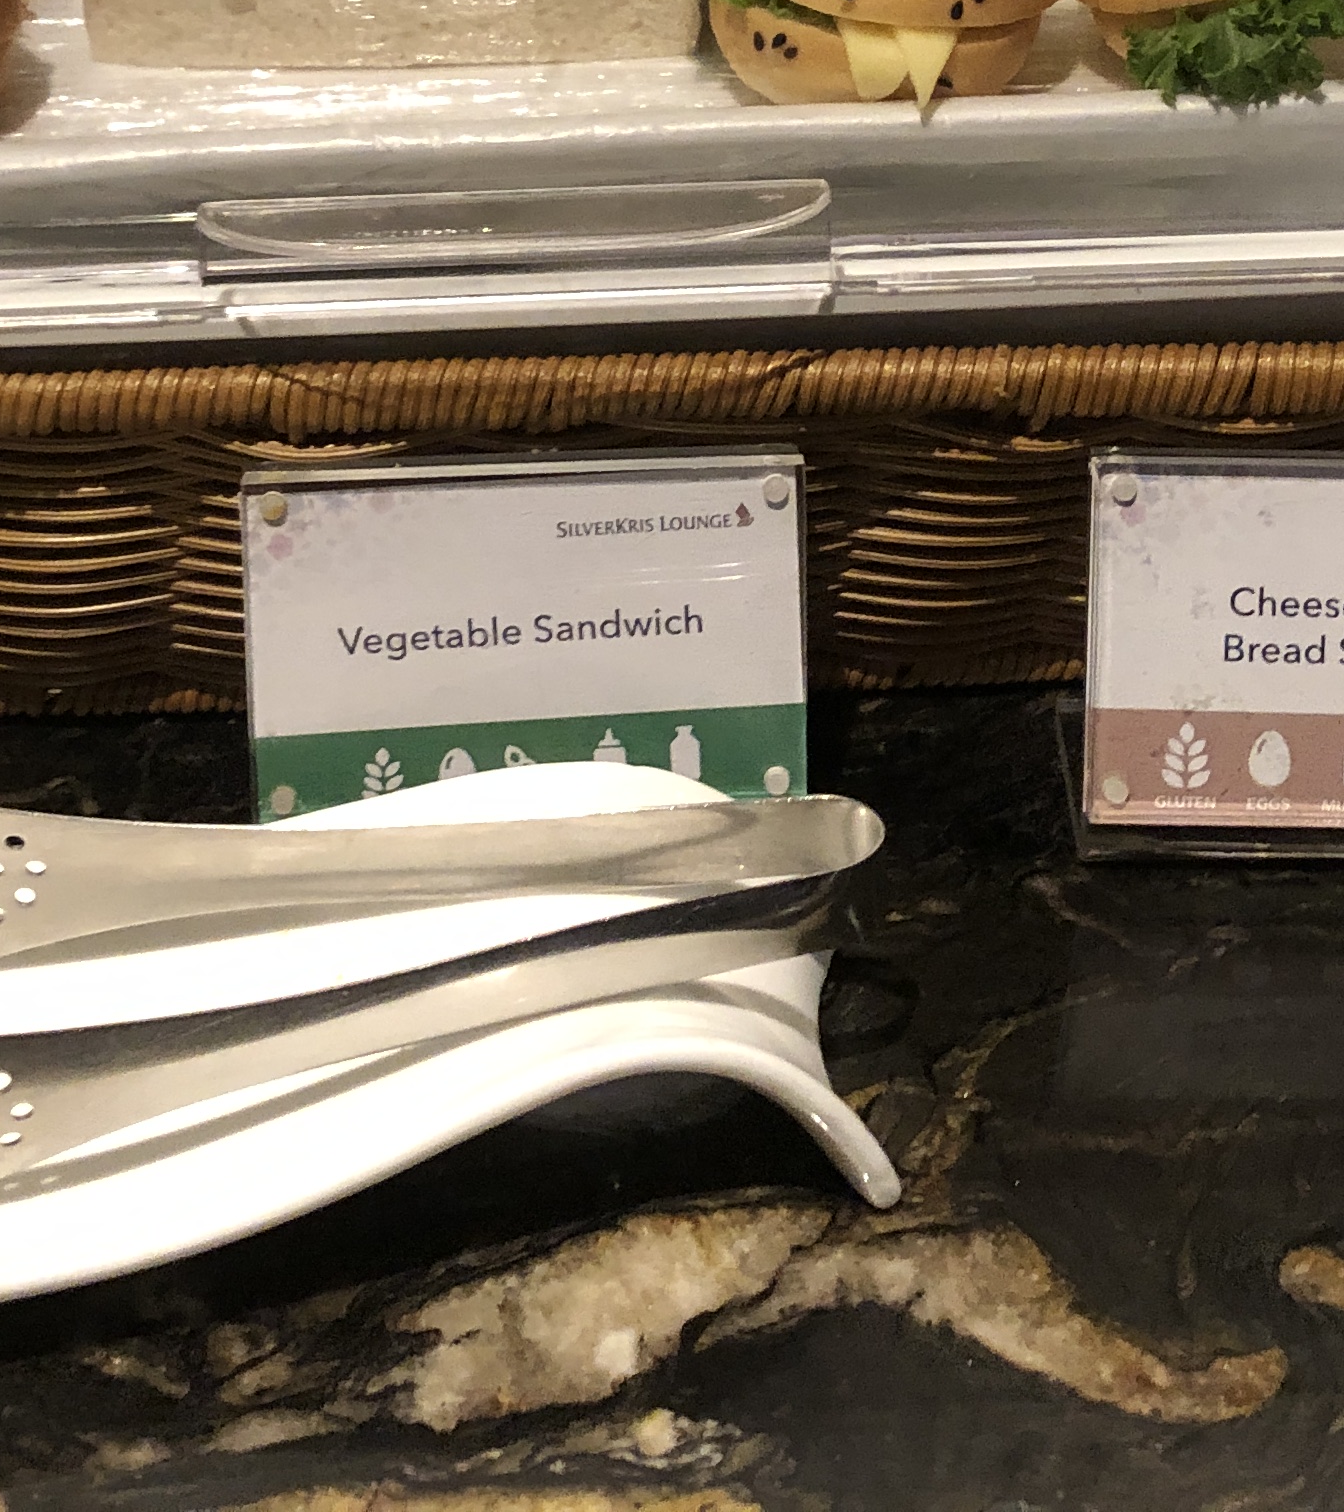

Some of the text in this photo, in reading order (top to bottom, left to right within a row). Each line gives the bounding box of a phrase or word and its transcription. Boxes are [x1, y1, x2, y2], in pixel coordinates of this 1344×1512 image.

[660, 512, 732, 532] LOUNGE
[338, 605, 704, 660] Vegetable Sandwich
[1222, 634, 1326, 666] Bread
[1154, 795, 1216, 809] GLUTEN
[1246, 797, 1291, 812] EGGS
